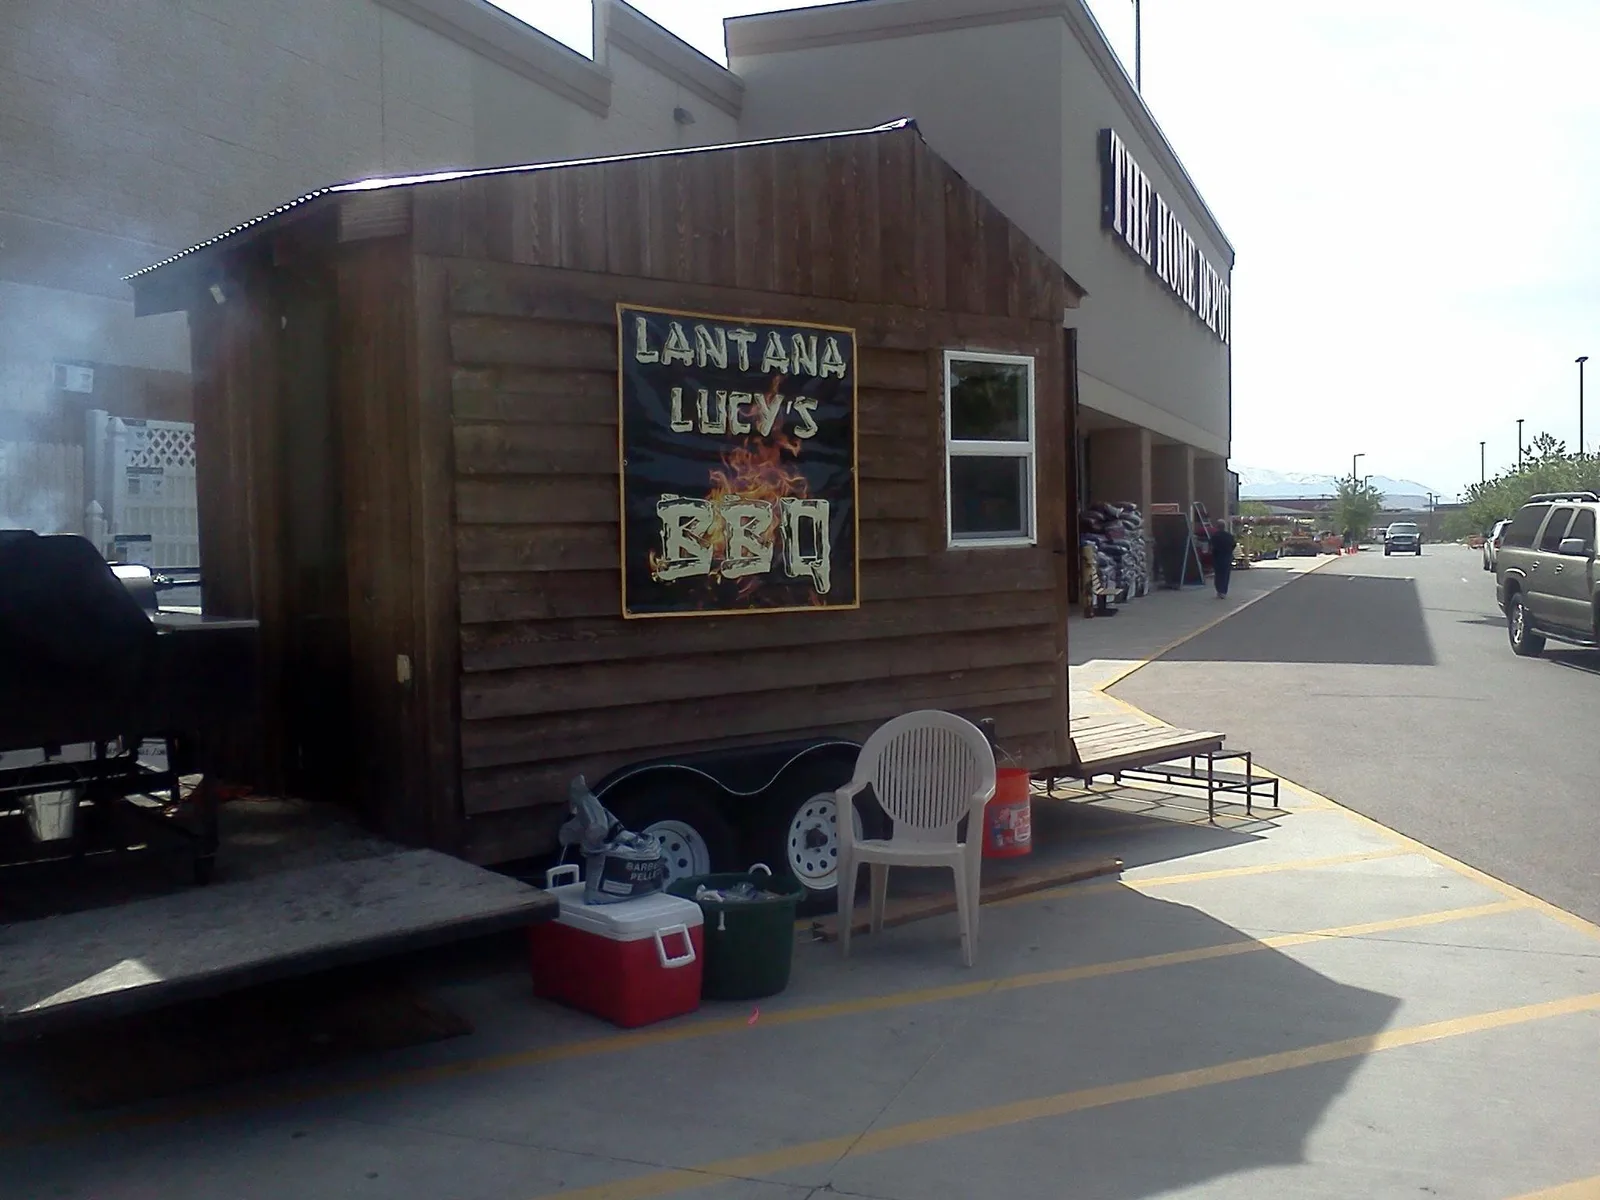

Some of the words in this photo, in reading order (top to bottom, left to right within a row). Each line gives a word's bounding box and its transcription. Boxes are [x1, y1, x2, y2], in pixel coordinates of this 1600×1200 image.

[1110, 128, 1151, 266] THE
[1156, 192, 1195, 311] HOME
[1199, 250, 1230, 344] DEPOT
[635, 317, 846, 378] LANTANA
[670, 387, 819, 438] LUCY'S
[656, 494, 831, 594] BBQ
